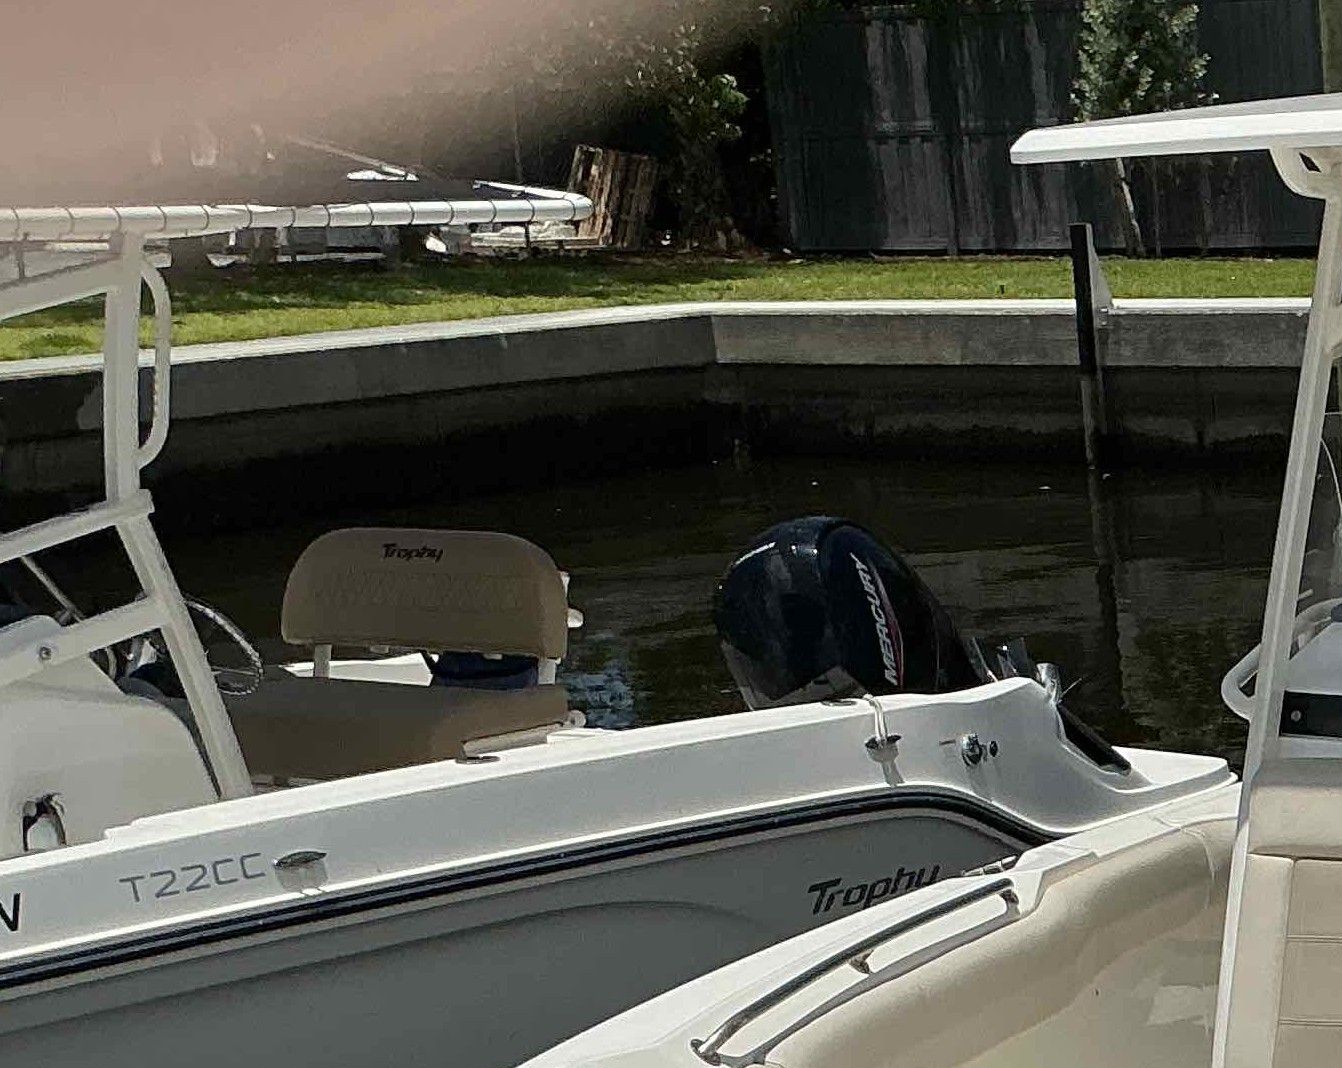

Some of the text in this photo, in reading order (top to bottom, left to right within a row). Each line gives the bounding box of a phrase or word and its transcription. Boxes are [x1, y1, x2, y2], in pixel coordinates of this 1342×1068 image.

[849, 551, 899, 686] MERCURY
[119, 852, 267, 903] T22CC
[807, 864, 941, 916] Trophy
